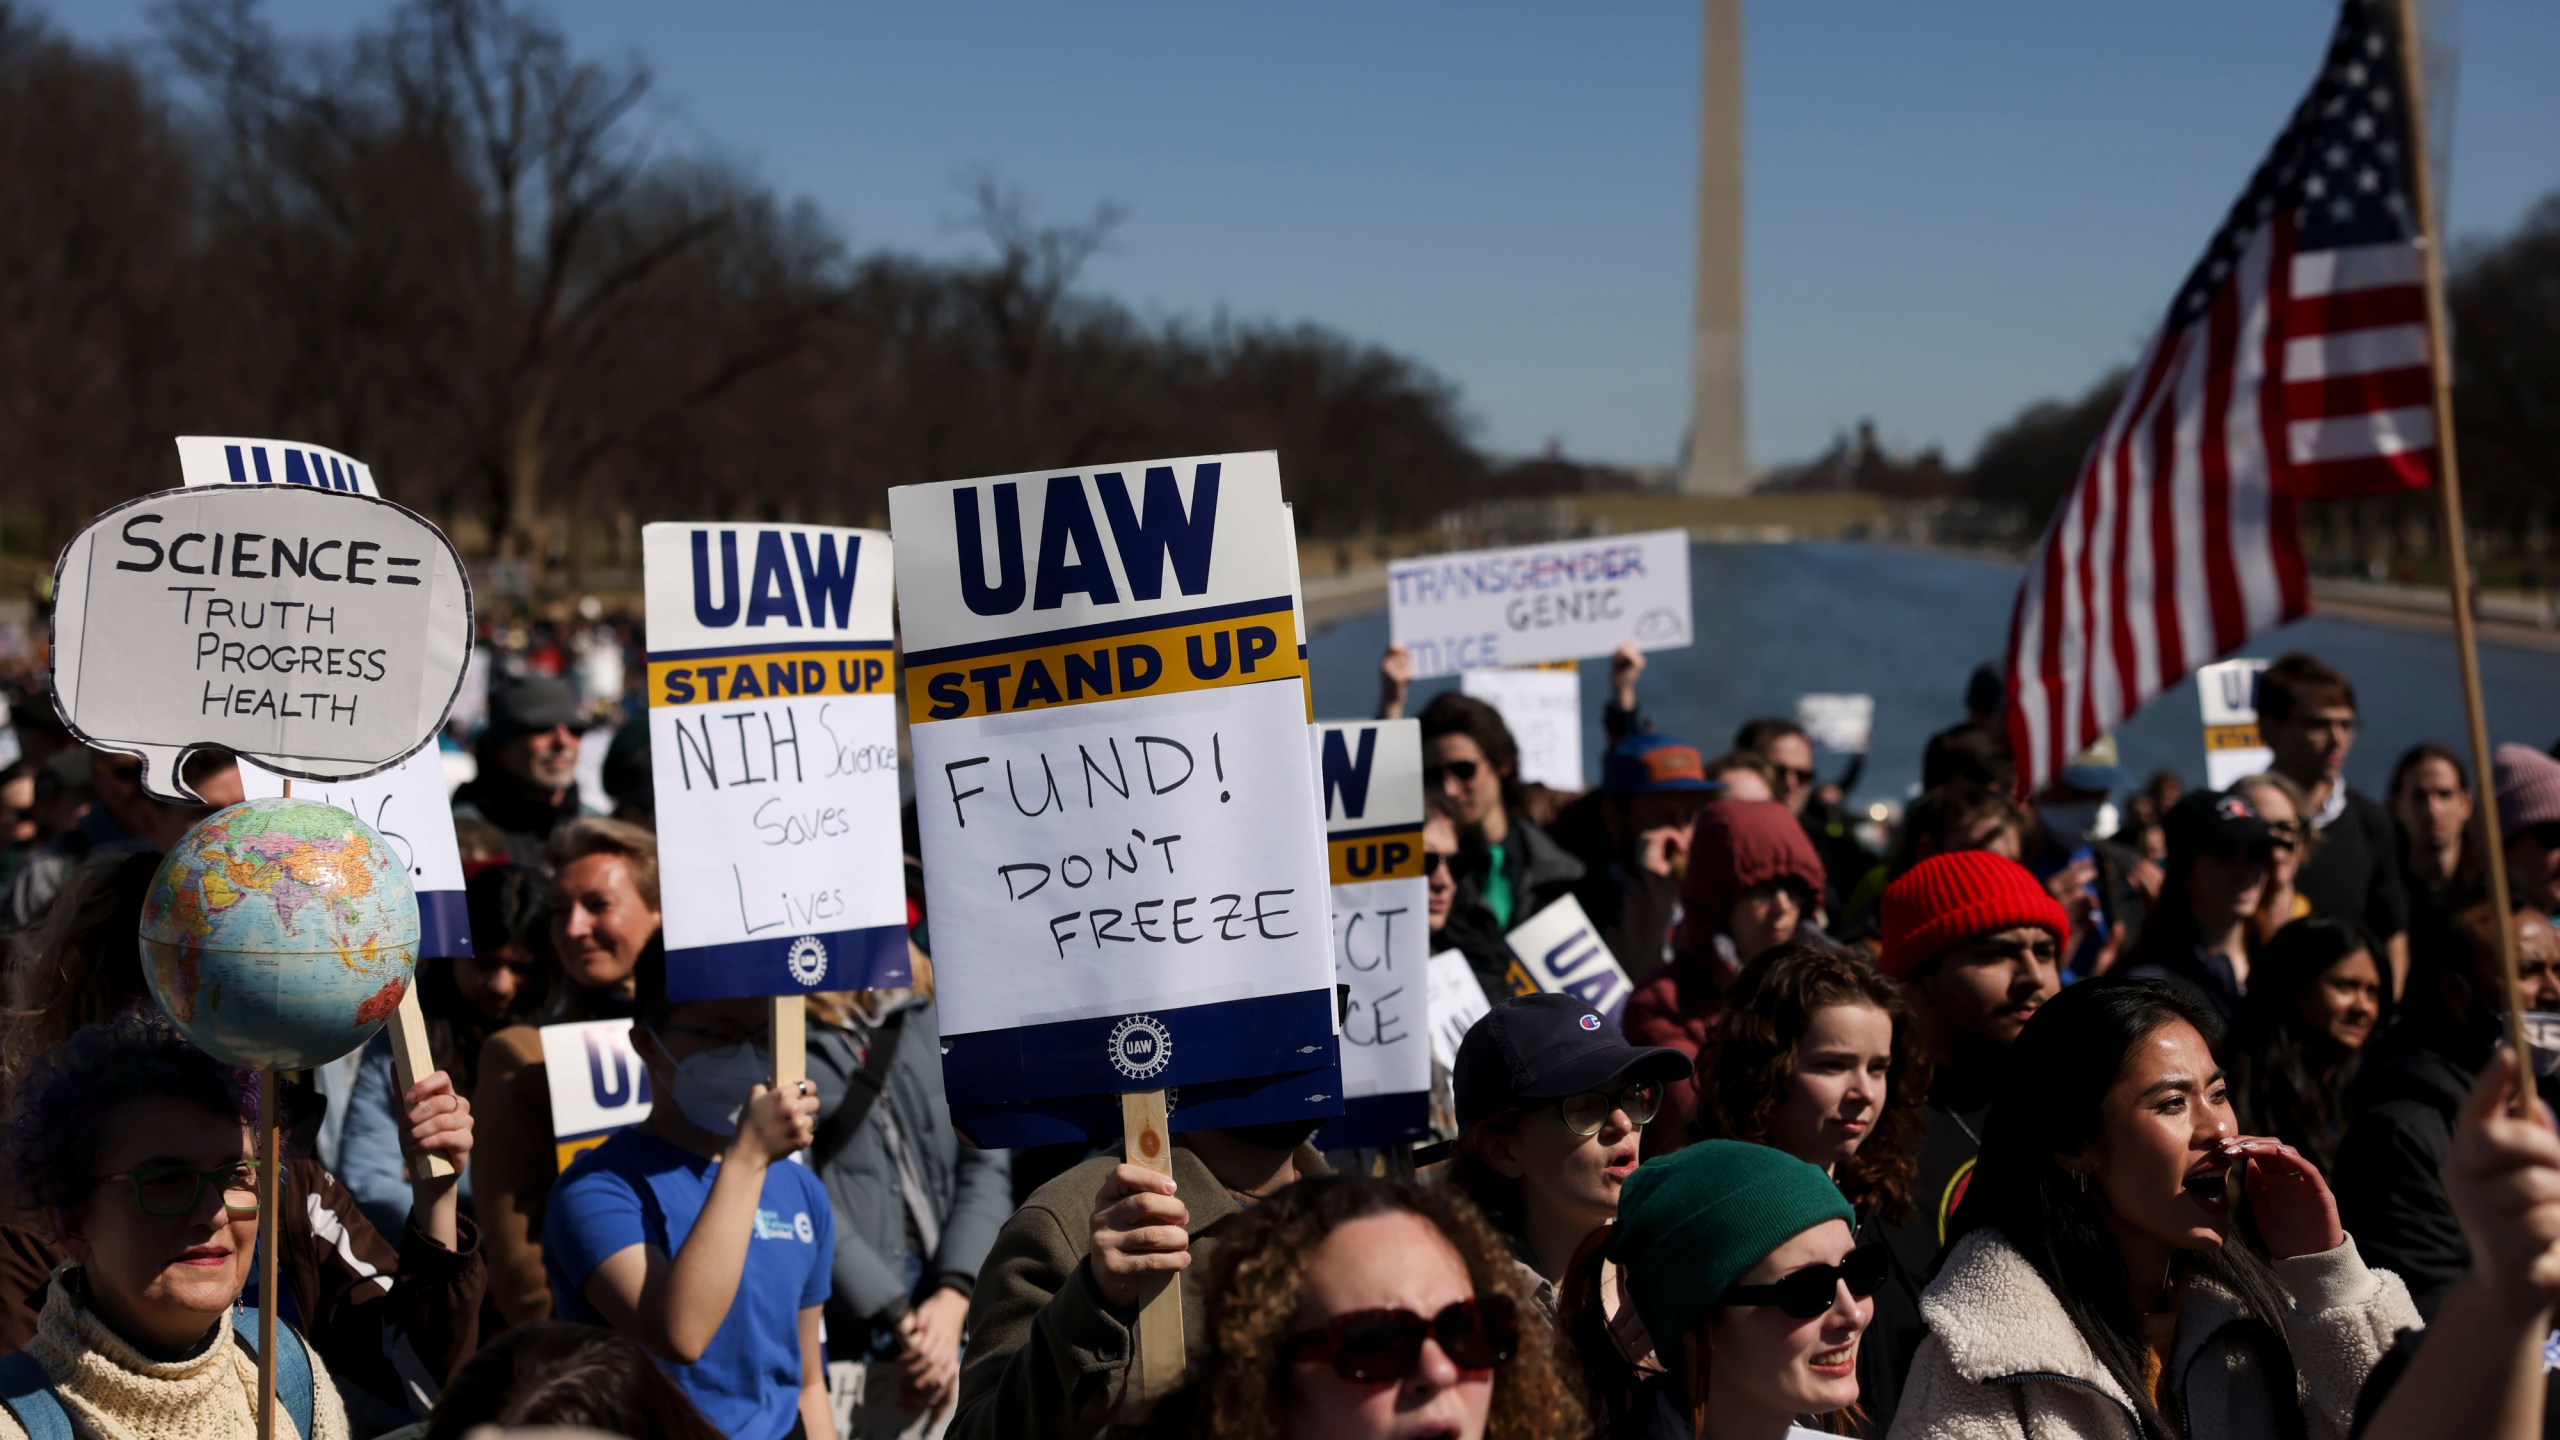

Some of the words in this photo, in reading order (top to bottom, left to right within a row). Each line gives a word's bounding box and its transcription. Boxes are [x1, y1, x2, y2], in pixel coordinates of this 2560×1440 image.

[953, 463, 1221, 616] UAW
[168, 586, 334, 634] TRUTH
[691, 531, 861, 630] UAW
[196, 632, 387, 681] PROGRESS
[664, 660, 827, 705] STAND
[838, 659, 884, 693] UP
[927, 643, 1163, 721] STAND
[1186, 625, 1277, 680] UP
[201, 680, 358, 726] HEALTH
[675, 706, 802, 791] NIH
[945, 732, 1233, 829] FUND!
[753, 797, 850, 846] Saves
[998, 828, 1181, 901] DON'T
[1346, 843, 1410, 877] UP
[733, 863, 845, 934] Lives
[1049, 889, 1299, 960] FREEZE
[1332, 907, 1408, 972] CT
[1126, 1039, 1152, 1055] UAW
